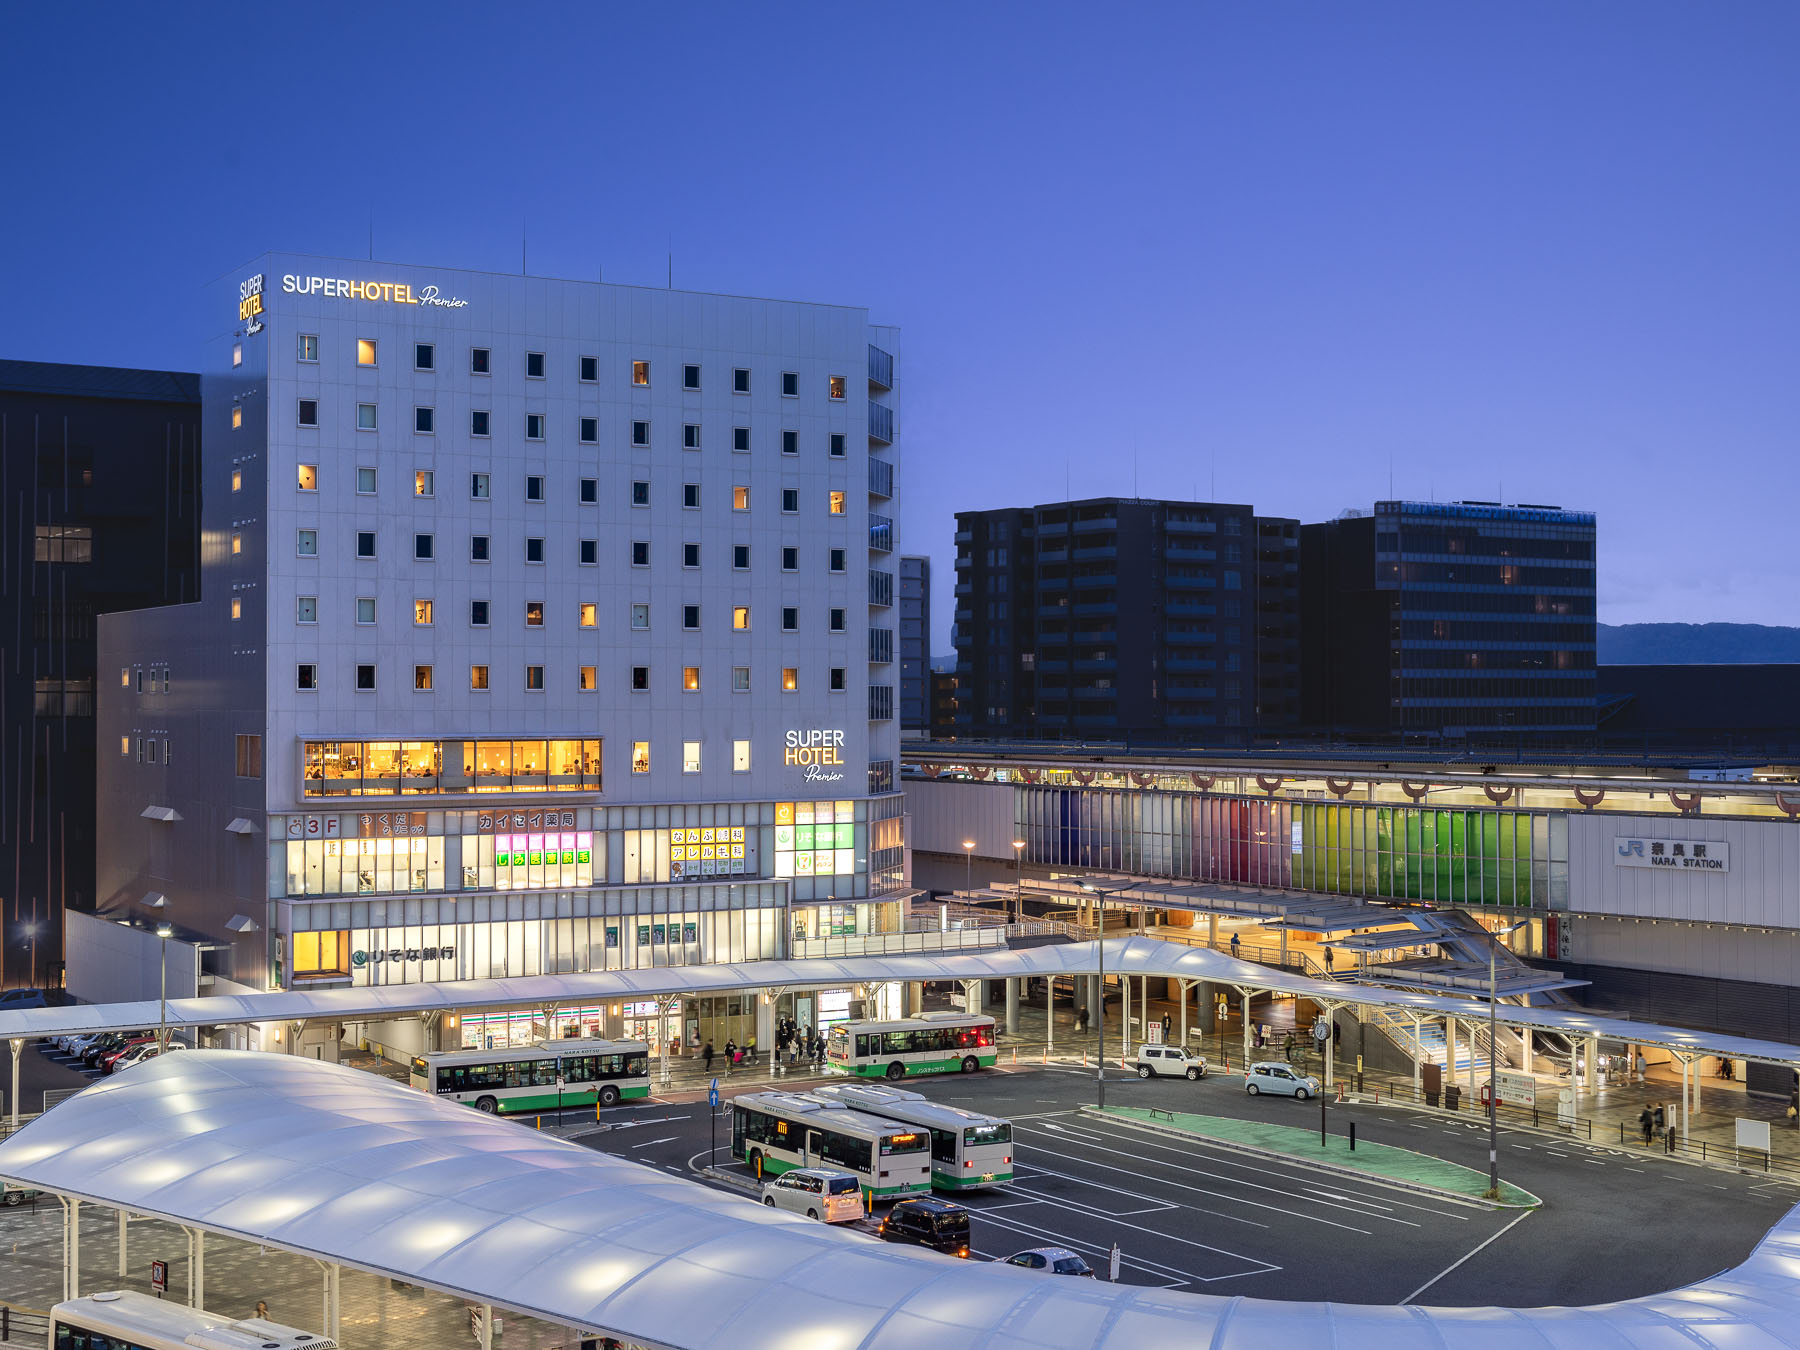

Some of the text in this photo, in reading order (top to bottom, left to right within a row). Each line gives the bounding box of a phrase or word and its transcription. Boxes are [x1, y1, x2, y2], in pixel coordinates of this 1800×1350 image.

[239, 273, 263, 301] SUPER
[418, 285, 468, 308] Premier
[239, 293, 263, 321] HOTEL
[785, 730, 845, 747] SUPER
[785, 747, 844, 765] HOTEL
[803, 764, 843, 782] Premier
[361, 813, 406, 825] つくだ
[480, 813, 574, 829] カイセイ薬局
[383, 825, 424, 834] クリニック
[1618, 840, 1645, 857] JR
[1651, 842, 1706, 857] 奈良駅
[1651, 857, 1723, 869] NARA STATION
[373, 946, 455, 963] りそな銀行
